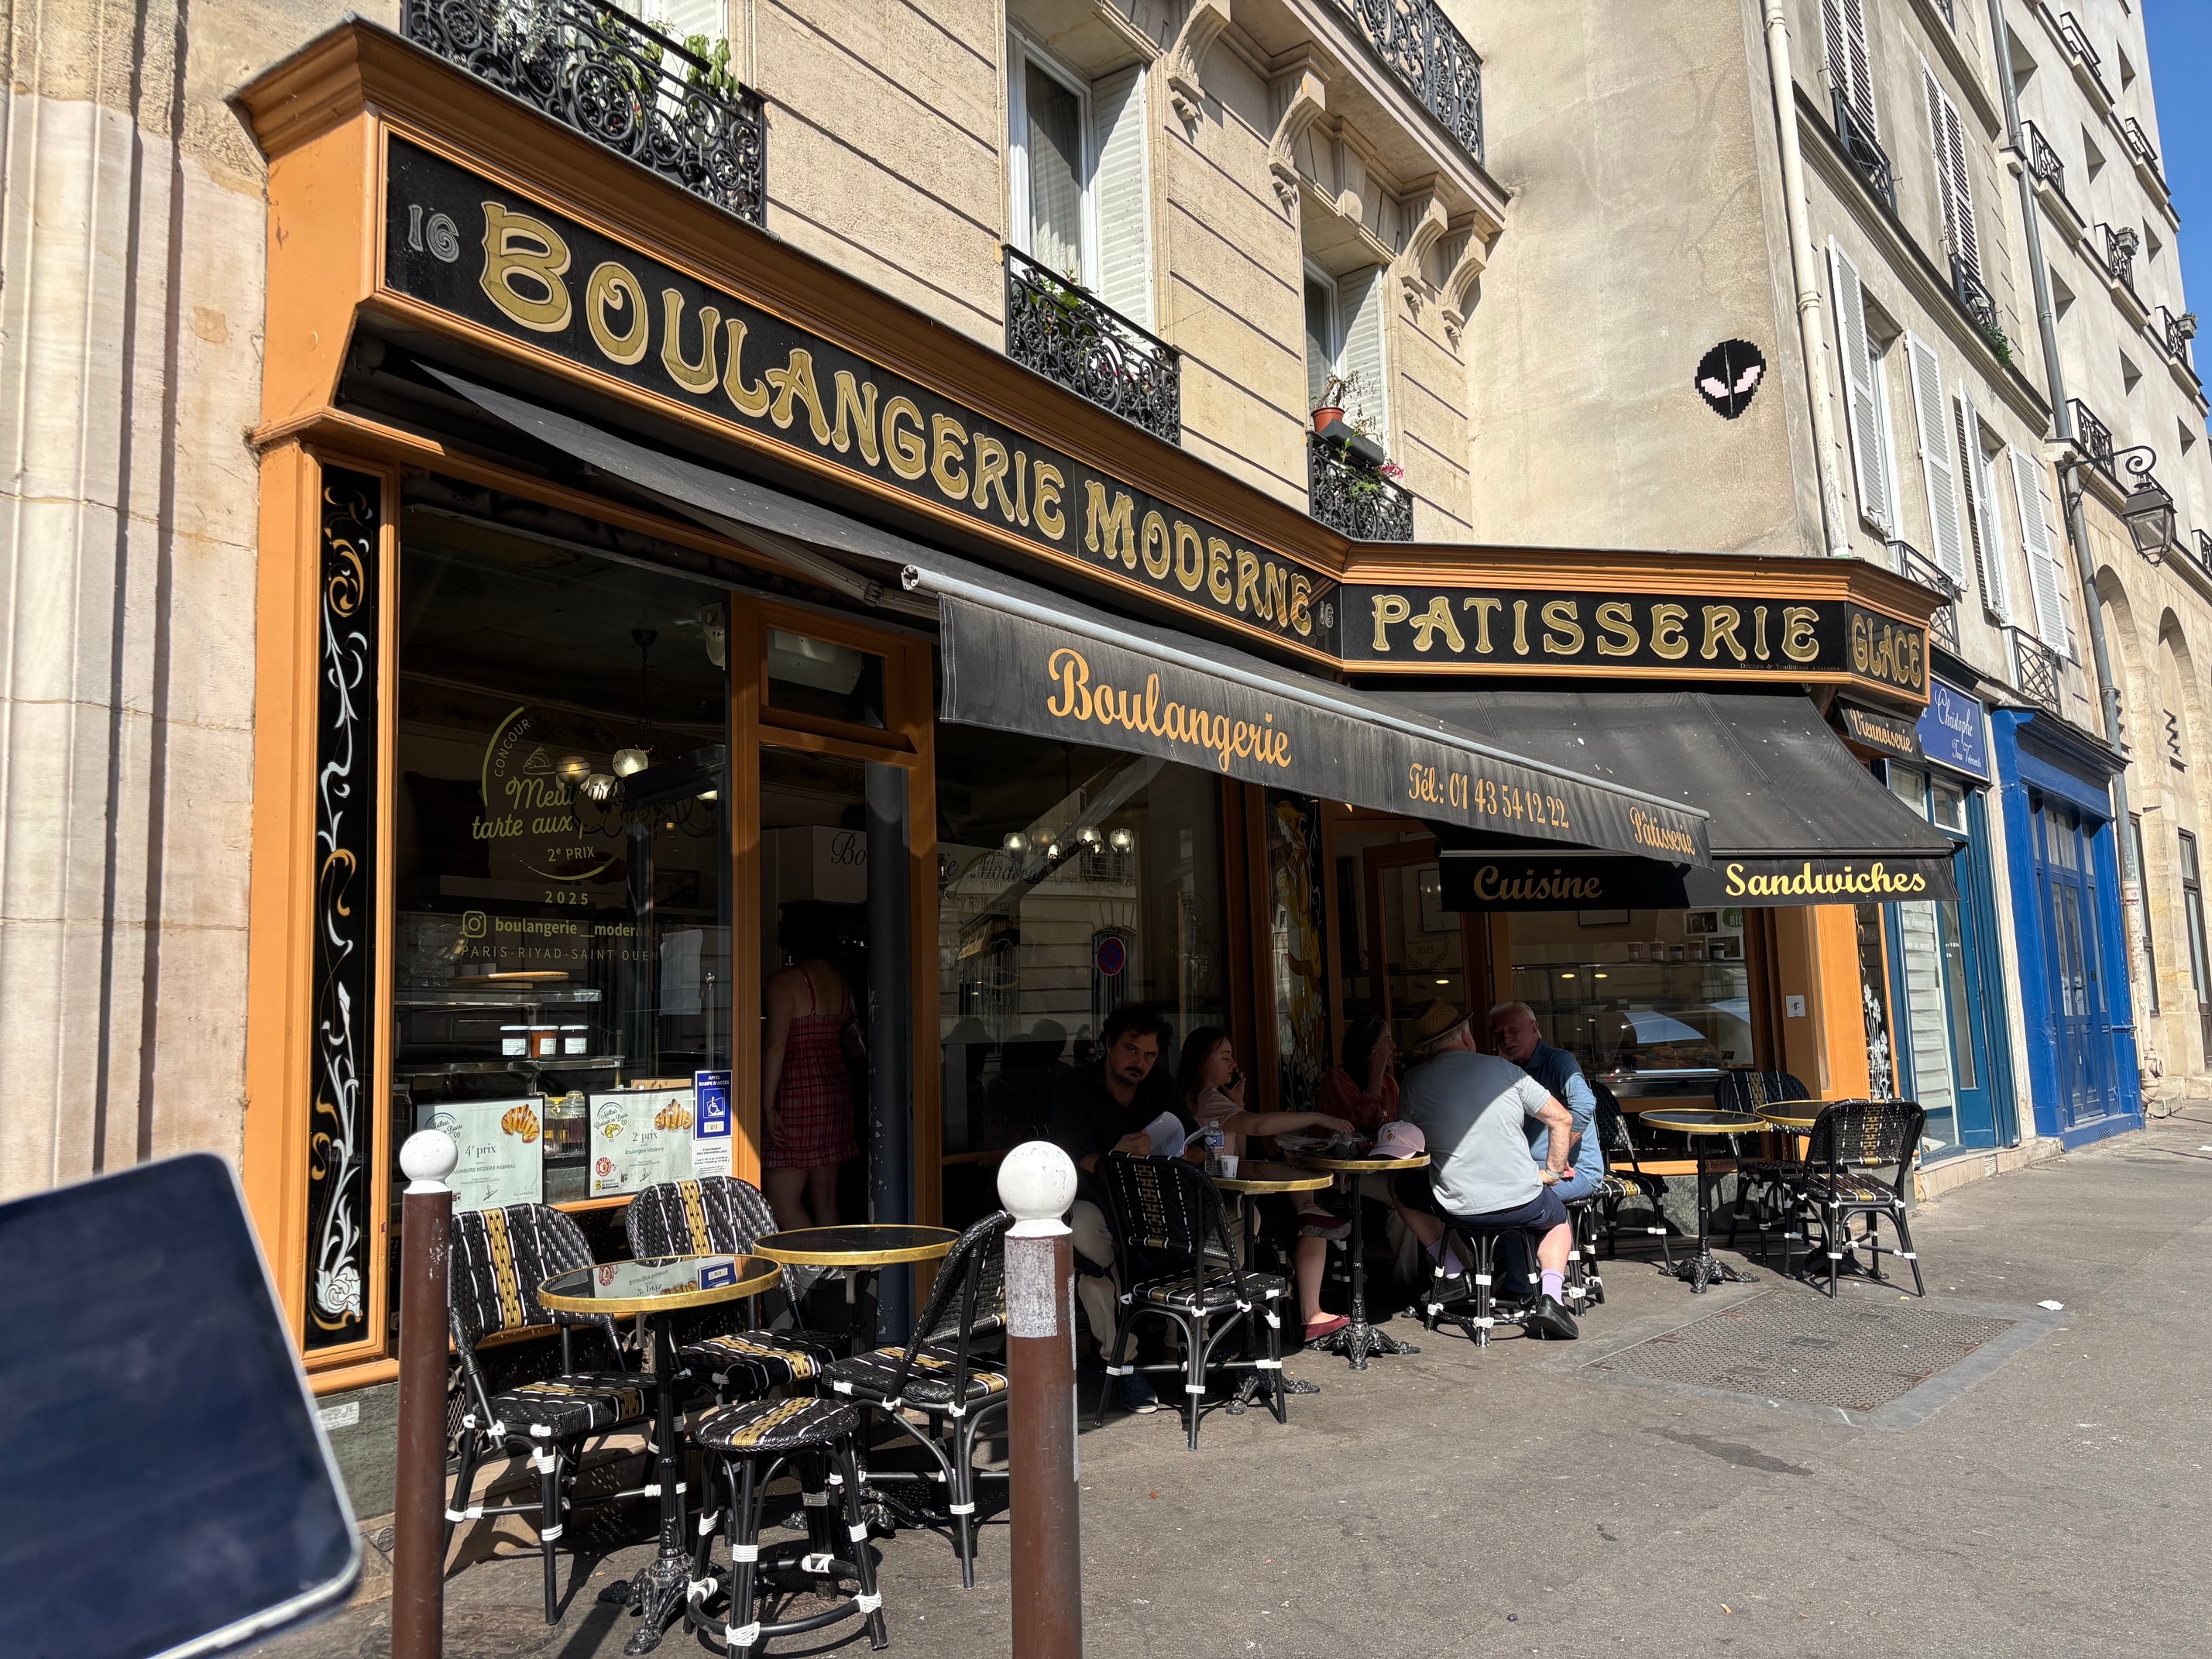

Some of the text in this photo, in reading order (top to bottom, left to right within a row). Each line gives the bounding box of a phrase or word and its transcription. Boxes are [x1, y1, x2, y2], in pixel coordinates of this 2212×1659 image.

[407, 204, 460, 263] 16
[479, 201, 1312, 637] BOULANGERIE MODERNE
[1371, 593, 1819, 662] PATISSERIE
[1851, 613, 1922, 689] GLACE
[1047, 647, 1292, 773] Boulangerie
[1850, 707, 1913, 754] Viennoiserie
[1934, 688, 1973, 744] Christophe
[1449, 772, 1468, 810] 01
[1475, 778, 1498, 816] 43
[1502, 785, 1523, 820] 54
[1525, 793, 1546, 825] 12
[1547, 795, 1570, 830] 22
[472, 814, 524, 840] tarte
[532, 815, 573, 835] aux
[1630, 806, 1697, 856] Pâtisserie
[566, 846, 596, 860] PRIX
[544, 890, 589, 905] 2025
[1473, 864, 1603, 901] Cuisine
[1725, 861, 1927, 897] Sandwiches
[621, 950, 658, 961] OUEN
[476, 1142, 496, 1158] prix
[625, 1147, 647, 1156] Boulangerie
[641, 1130, 658, 1143] prix
